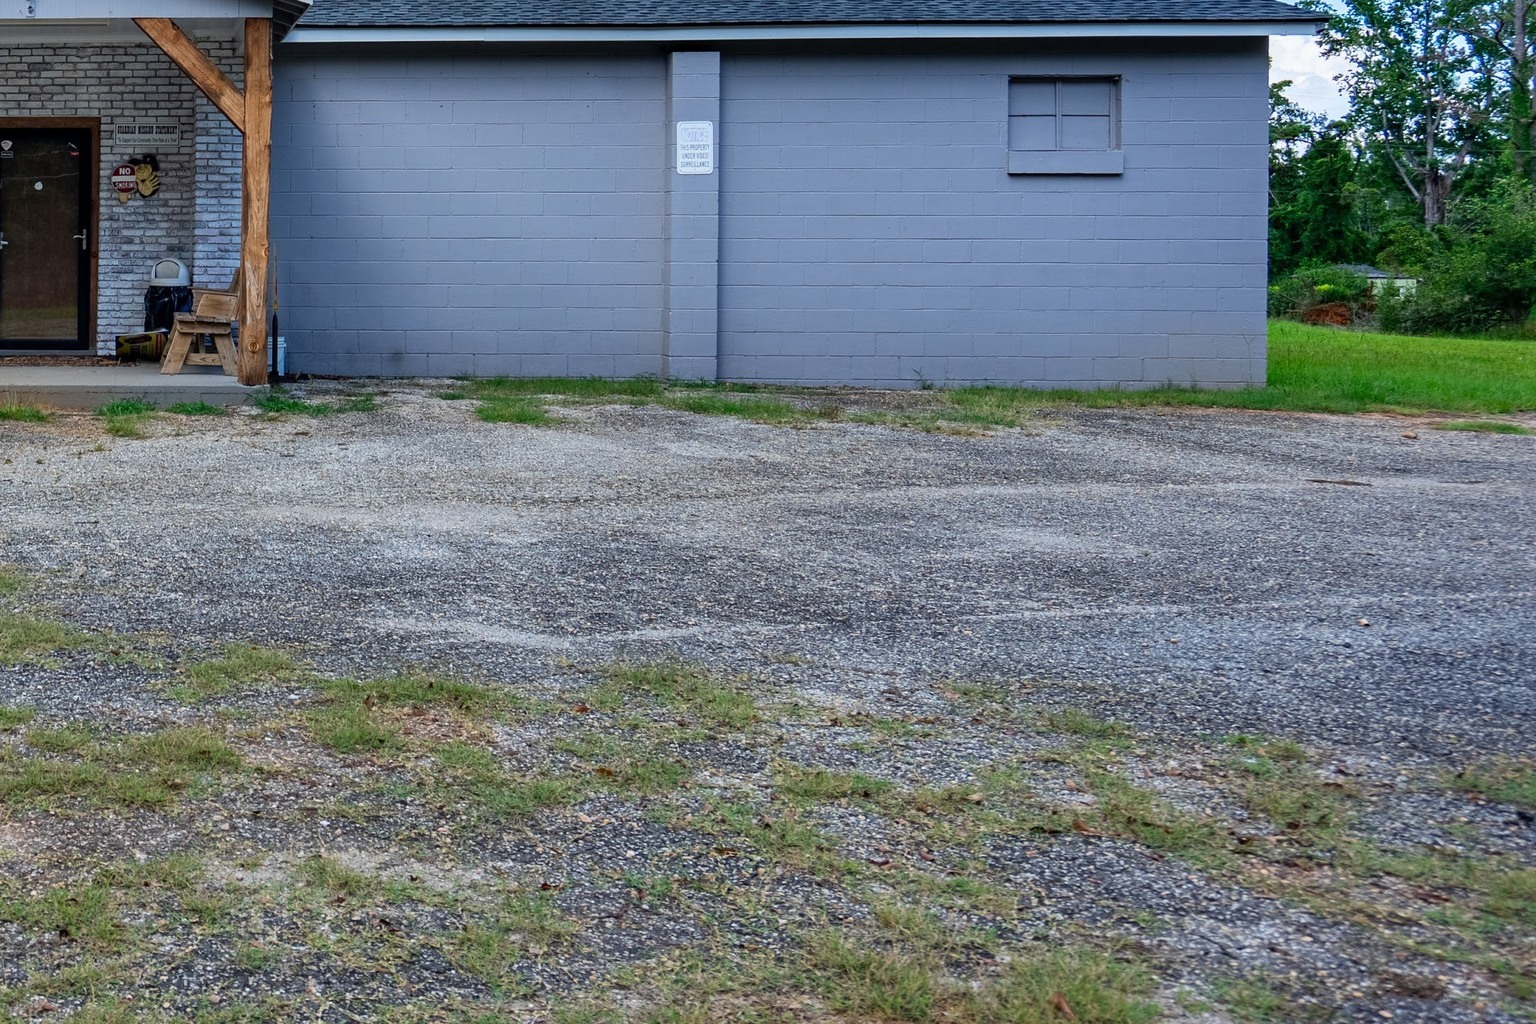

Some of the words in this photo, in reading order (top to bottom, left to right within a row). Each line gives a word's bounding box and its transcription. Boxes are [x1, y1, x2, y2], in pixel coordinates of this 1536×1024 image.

[155, 125, 177, 134] STATEMENT
[681, 128, 709, 142] NOTICE
[119, 167, 131, 175] NO
[115, 181, 137, 189] SMOKING
